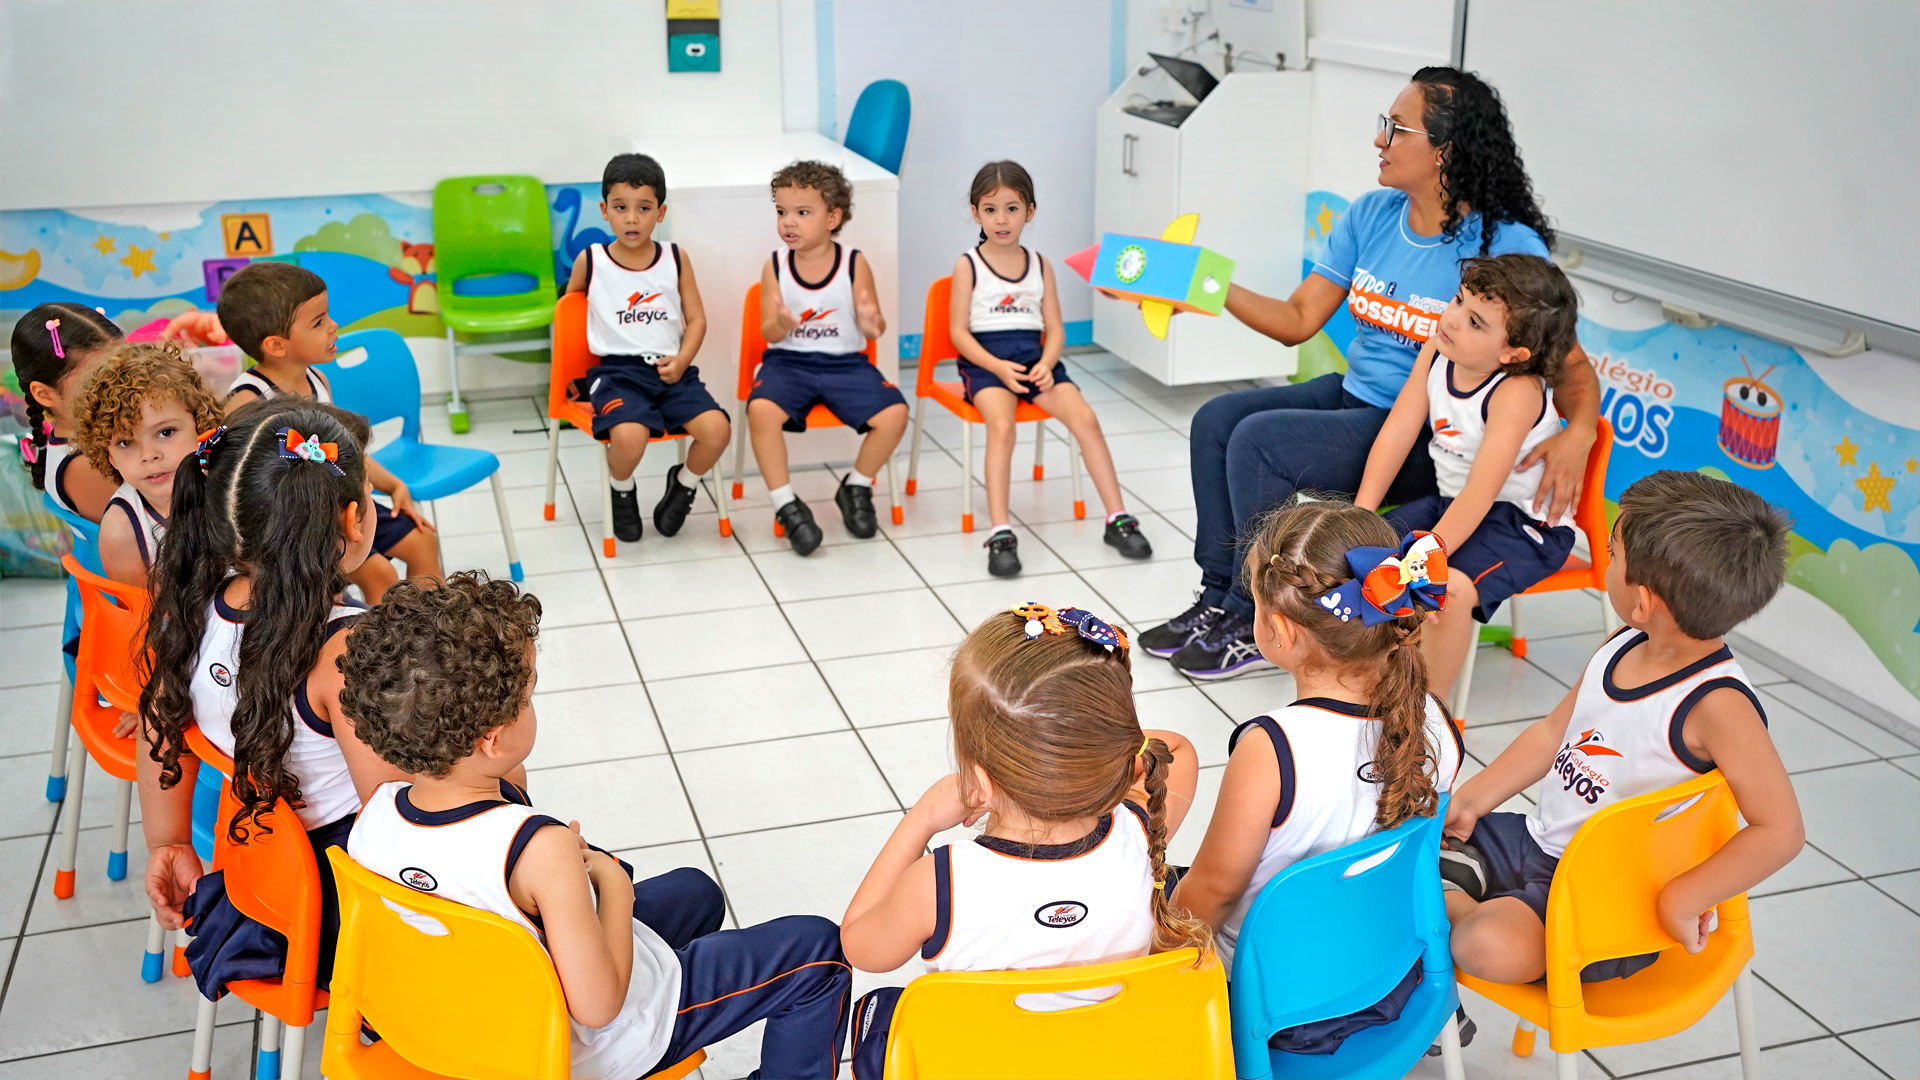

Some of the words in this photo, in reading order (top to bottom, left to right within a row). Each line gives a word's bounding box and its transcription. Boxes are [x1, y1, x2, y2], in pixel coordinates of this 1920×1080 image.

[235, 221, 262, 250] A
[1352, 267, 1385, 294] TUDO
[616, 309, 668, 325] Teleyos
[789, 325, 839, 340] eleyos
[1588, 355, 1674, 399] olégio
[1571, 752, 1610, 787] Colégio
[1047, 915, 1077, 925] Teleyos
